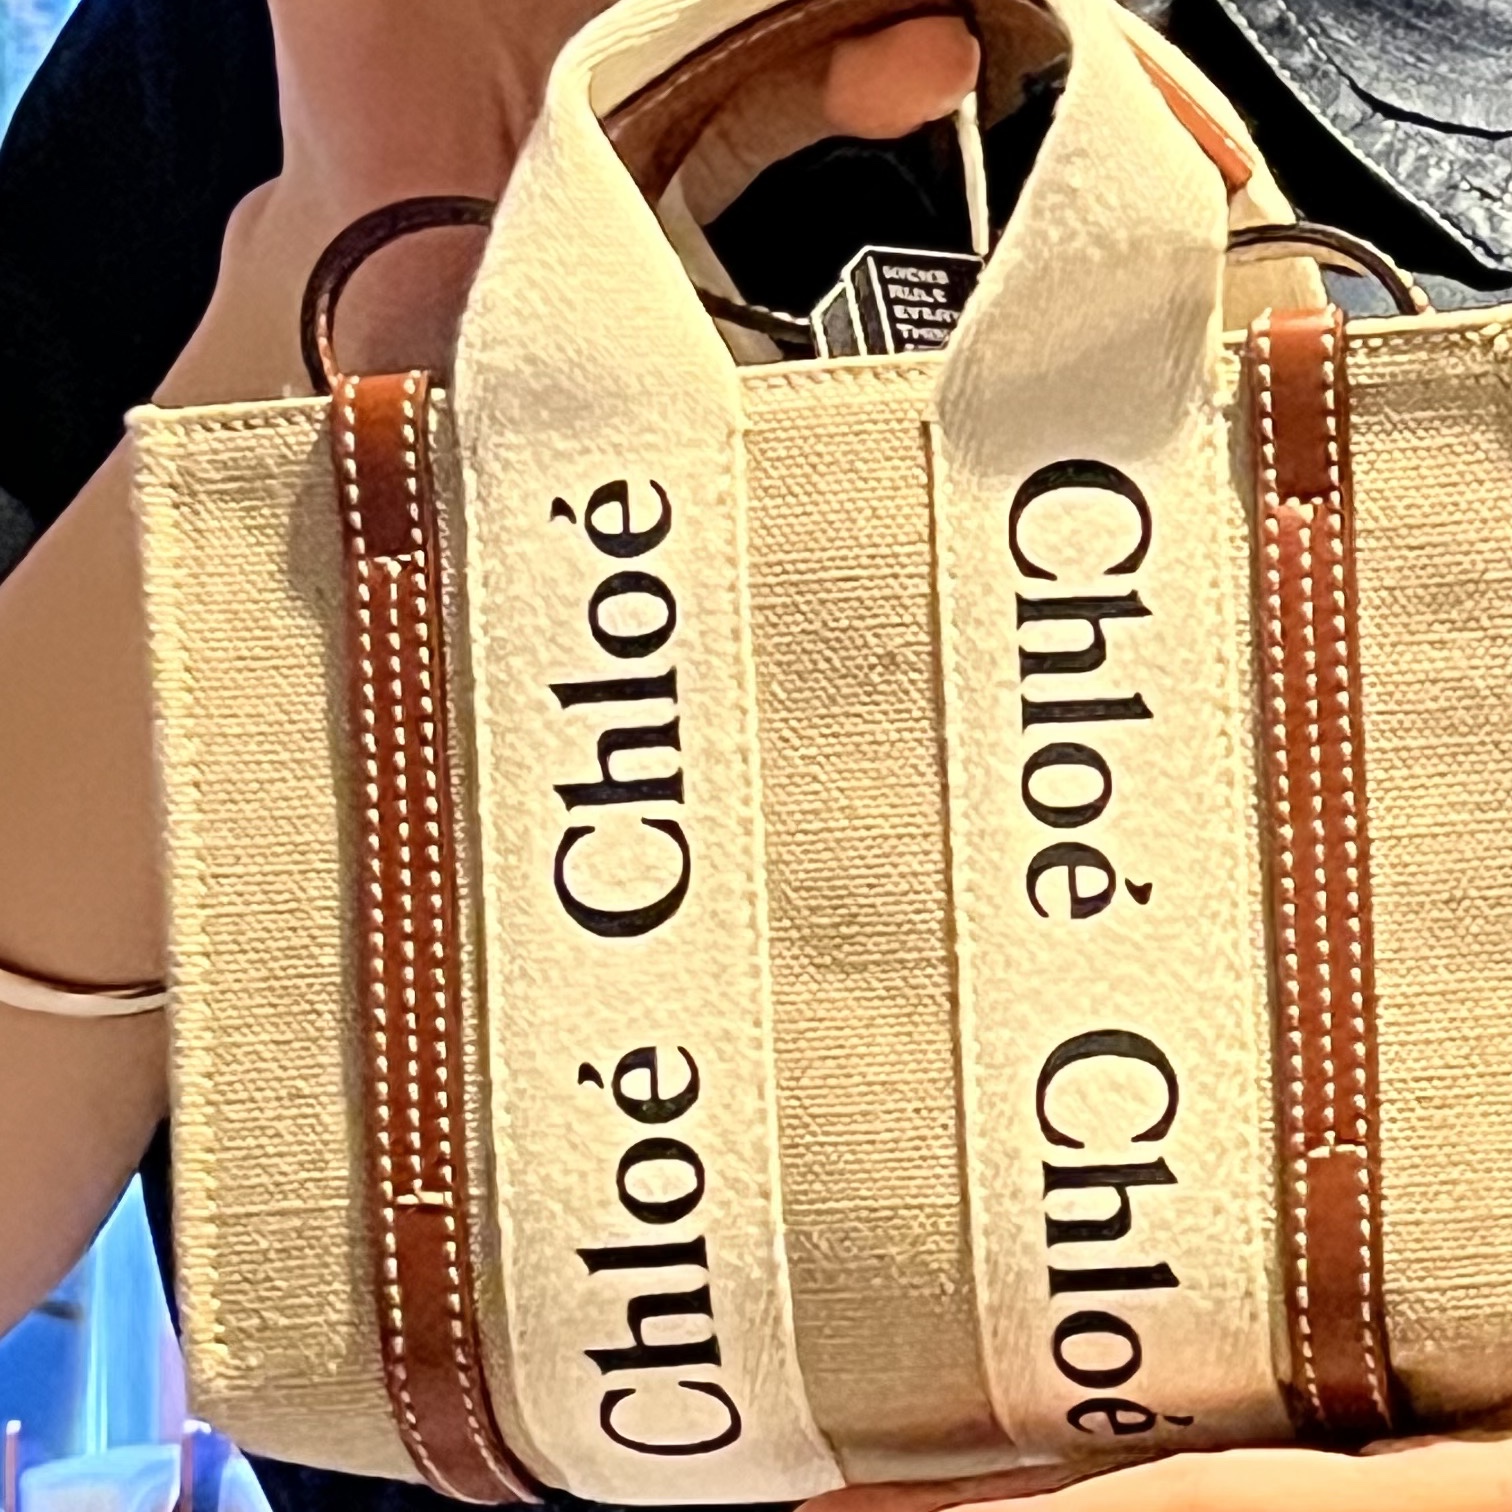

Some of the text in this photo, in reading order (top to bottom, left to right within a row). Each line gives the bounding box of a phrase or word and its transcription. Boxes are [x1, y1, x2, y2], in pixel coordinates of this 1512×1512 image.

[549, 478, 742, 1457] Chloé Chloé
[1007, 458, 1196, 1437] Chloé Chloé
